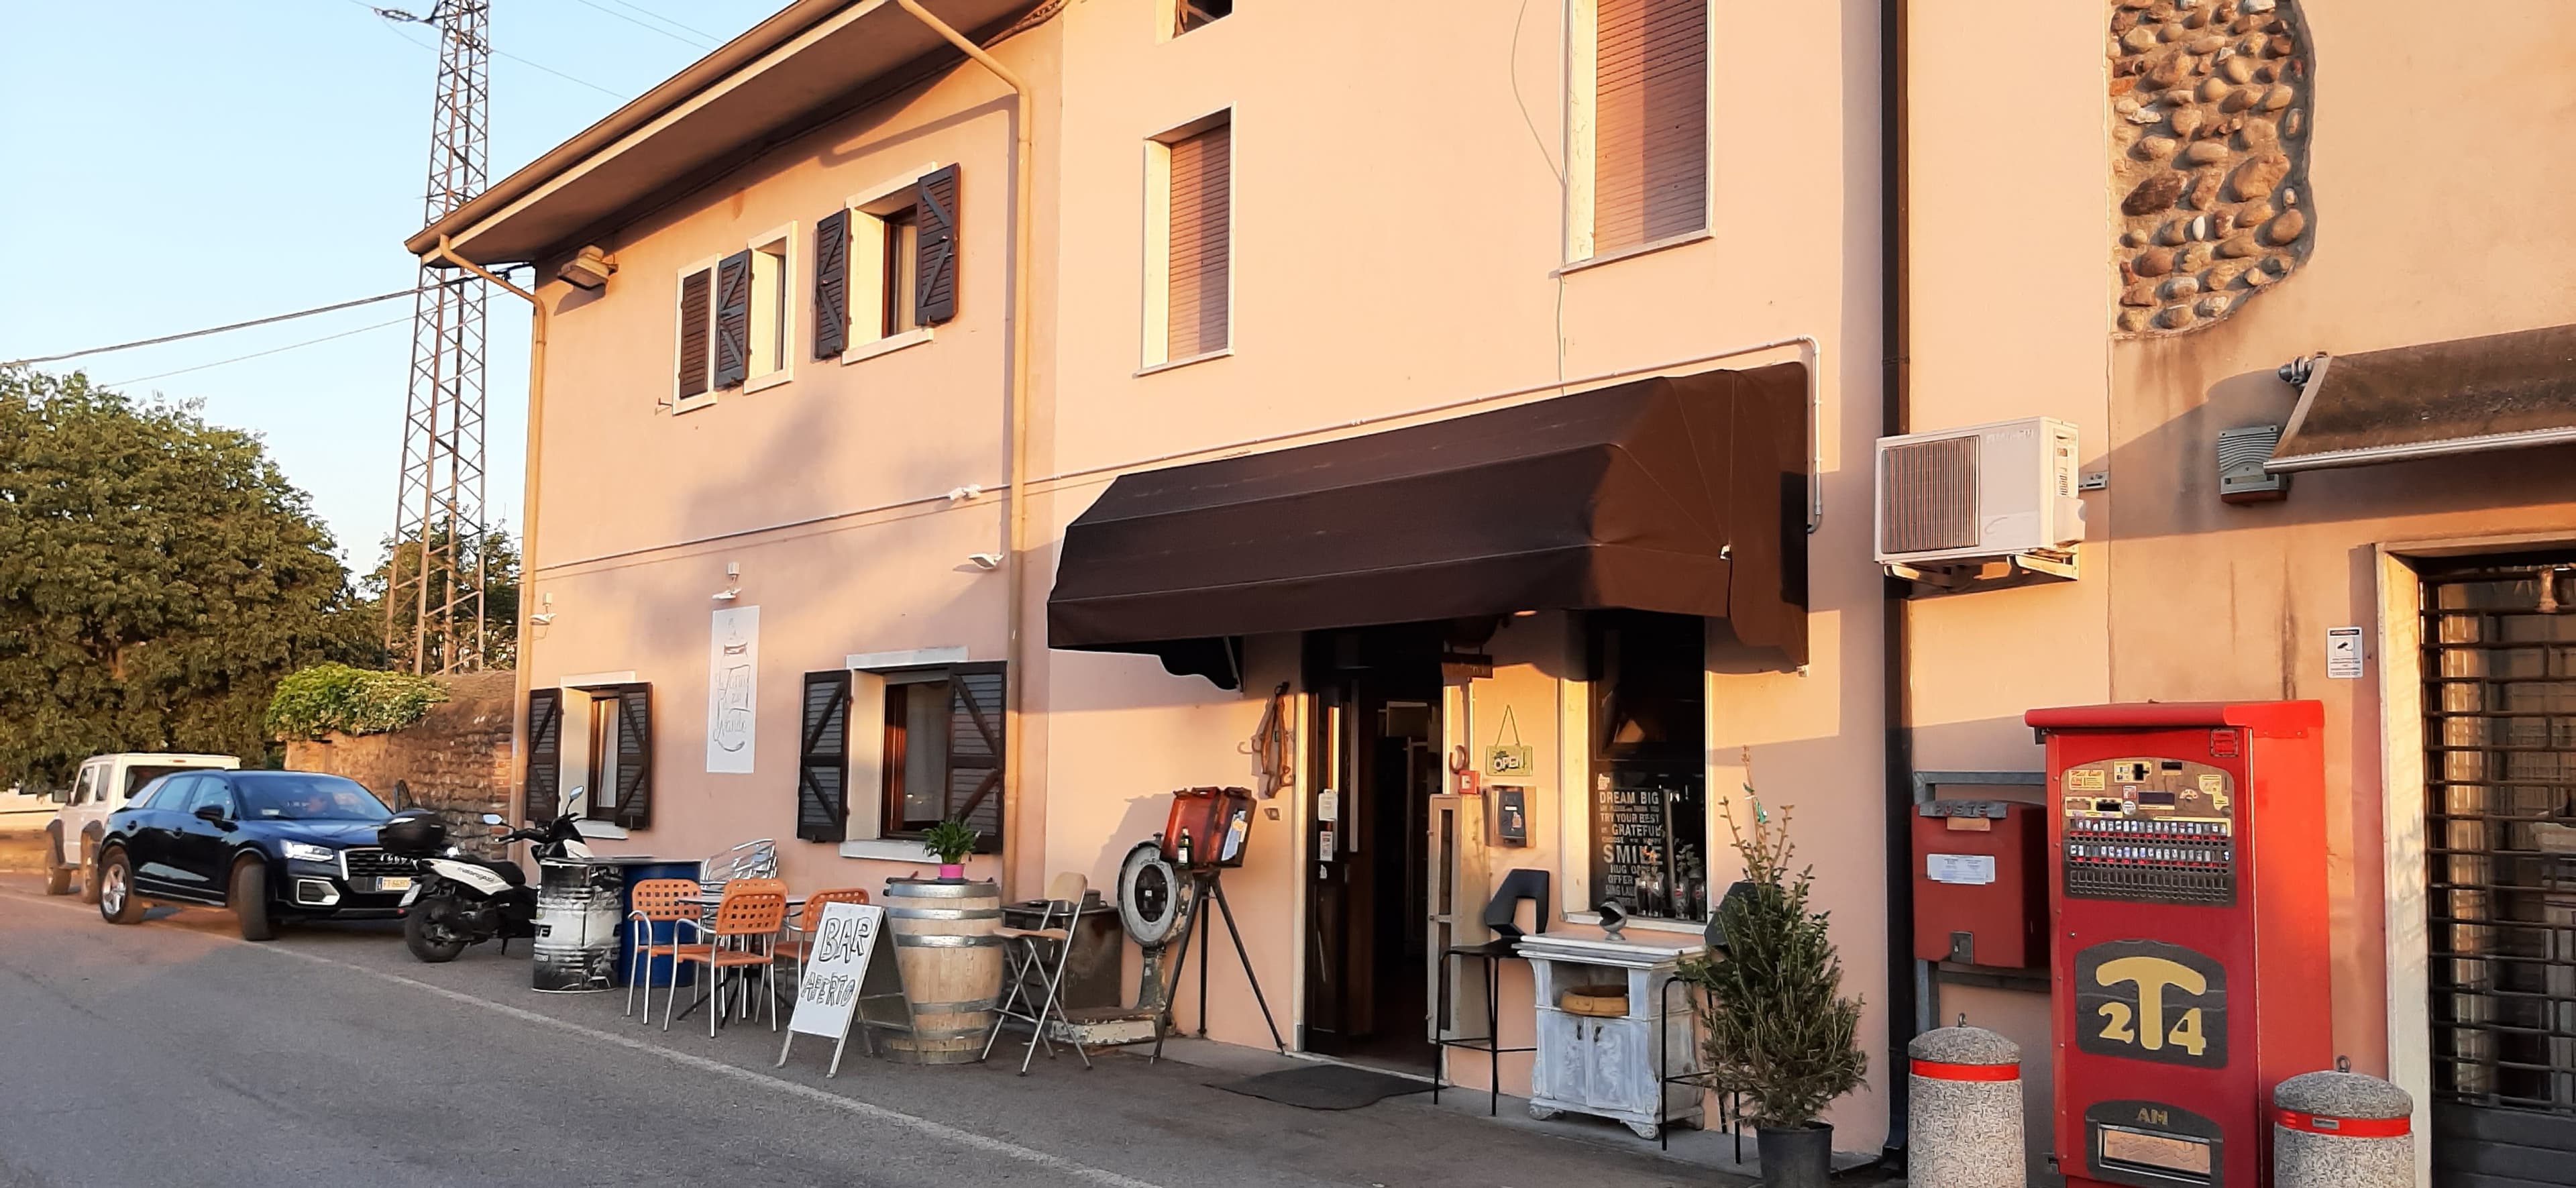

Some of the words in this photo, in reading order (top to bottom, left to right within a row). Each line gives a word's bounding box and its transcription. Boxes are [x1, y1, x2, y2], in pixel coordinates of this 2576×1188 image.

[1494, 754, 1524, 771] OPEN
[1600, 792, 1635, 804] DREAM
[1641, 792, 1659, 804] BIG
[1935, 805, 1988, 816] POSTE
[1601, 813, 1615, 822] TRY
[1615, 813, 1637, 822] YOUR
[1640, 814, 1659, 824] BEST
[1612, 824, 1662, 836] GRATEFUL
[1603, 844, 1663, 865] SMILE
[1610, 864, 1627, 874] HUG
[1607, 874, 1633, 885] OFFER
[818, 917, 873, 964] BAR
[800, 971, 856, 1007] APERTO
